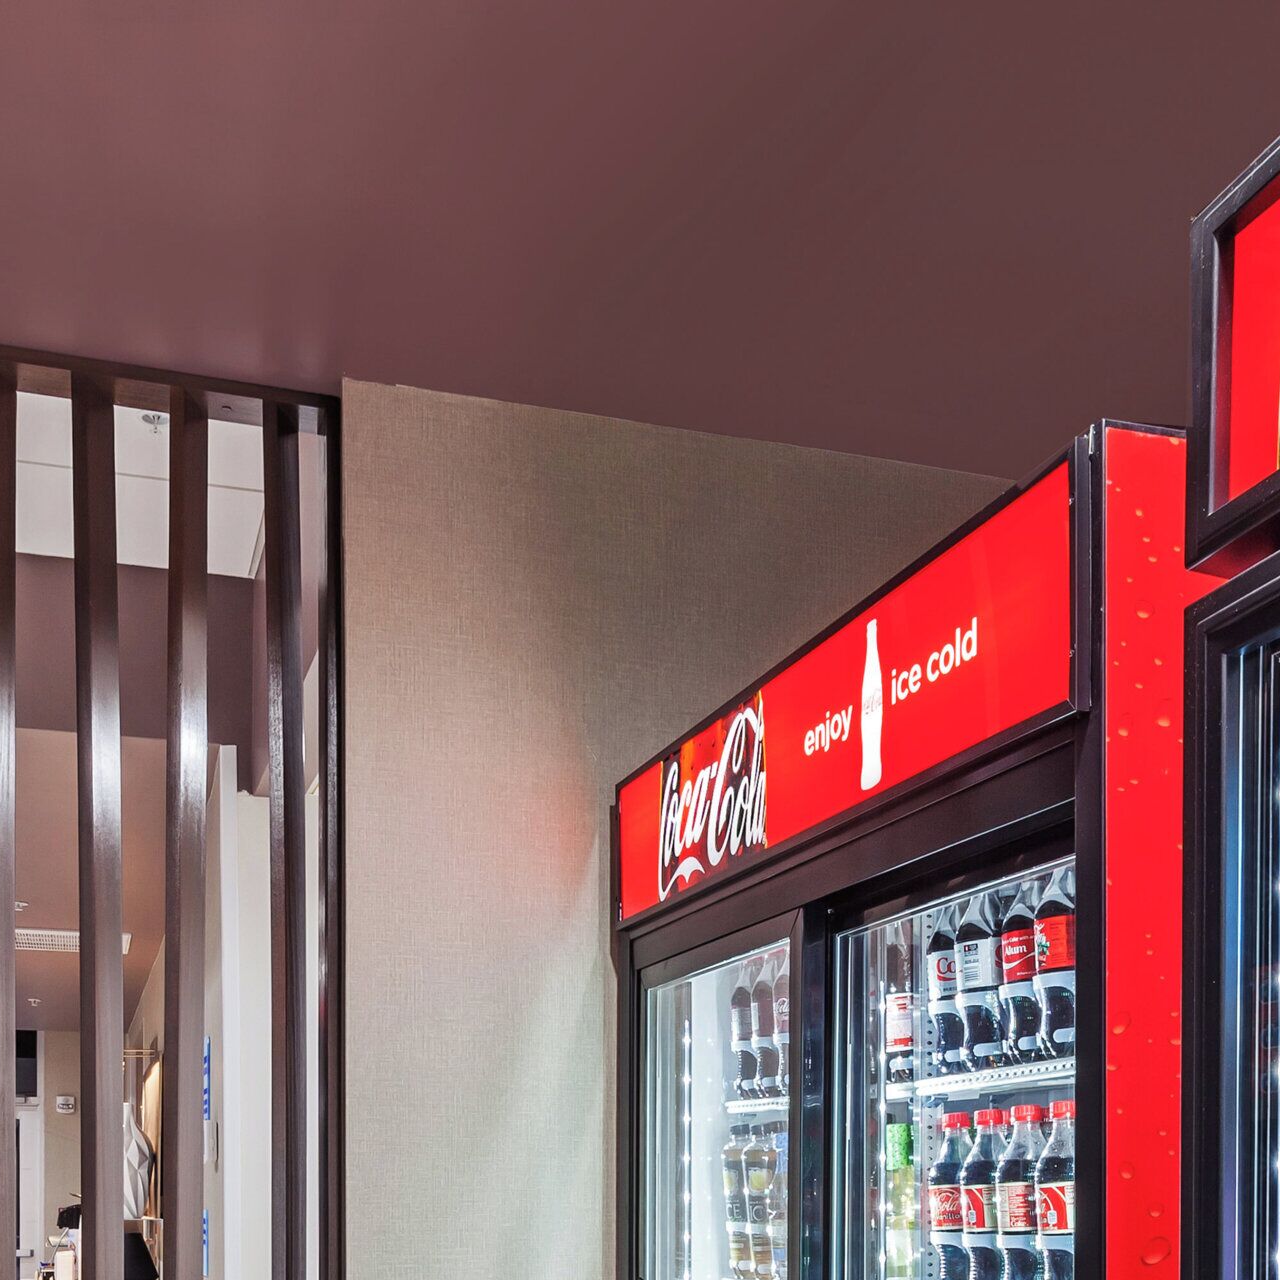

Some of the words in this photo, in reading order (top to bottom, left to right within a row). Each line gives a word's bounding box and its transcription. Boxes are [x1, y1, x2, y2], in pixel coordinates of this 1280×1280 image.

[891, 663, 921, 705] ice
[926, 618, 977, 682] cold
[804, 703, 853, 756] enjoy
[659, 706, 767, 901] Coca-Cola
